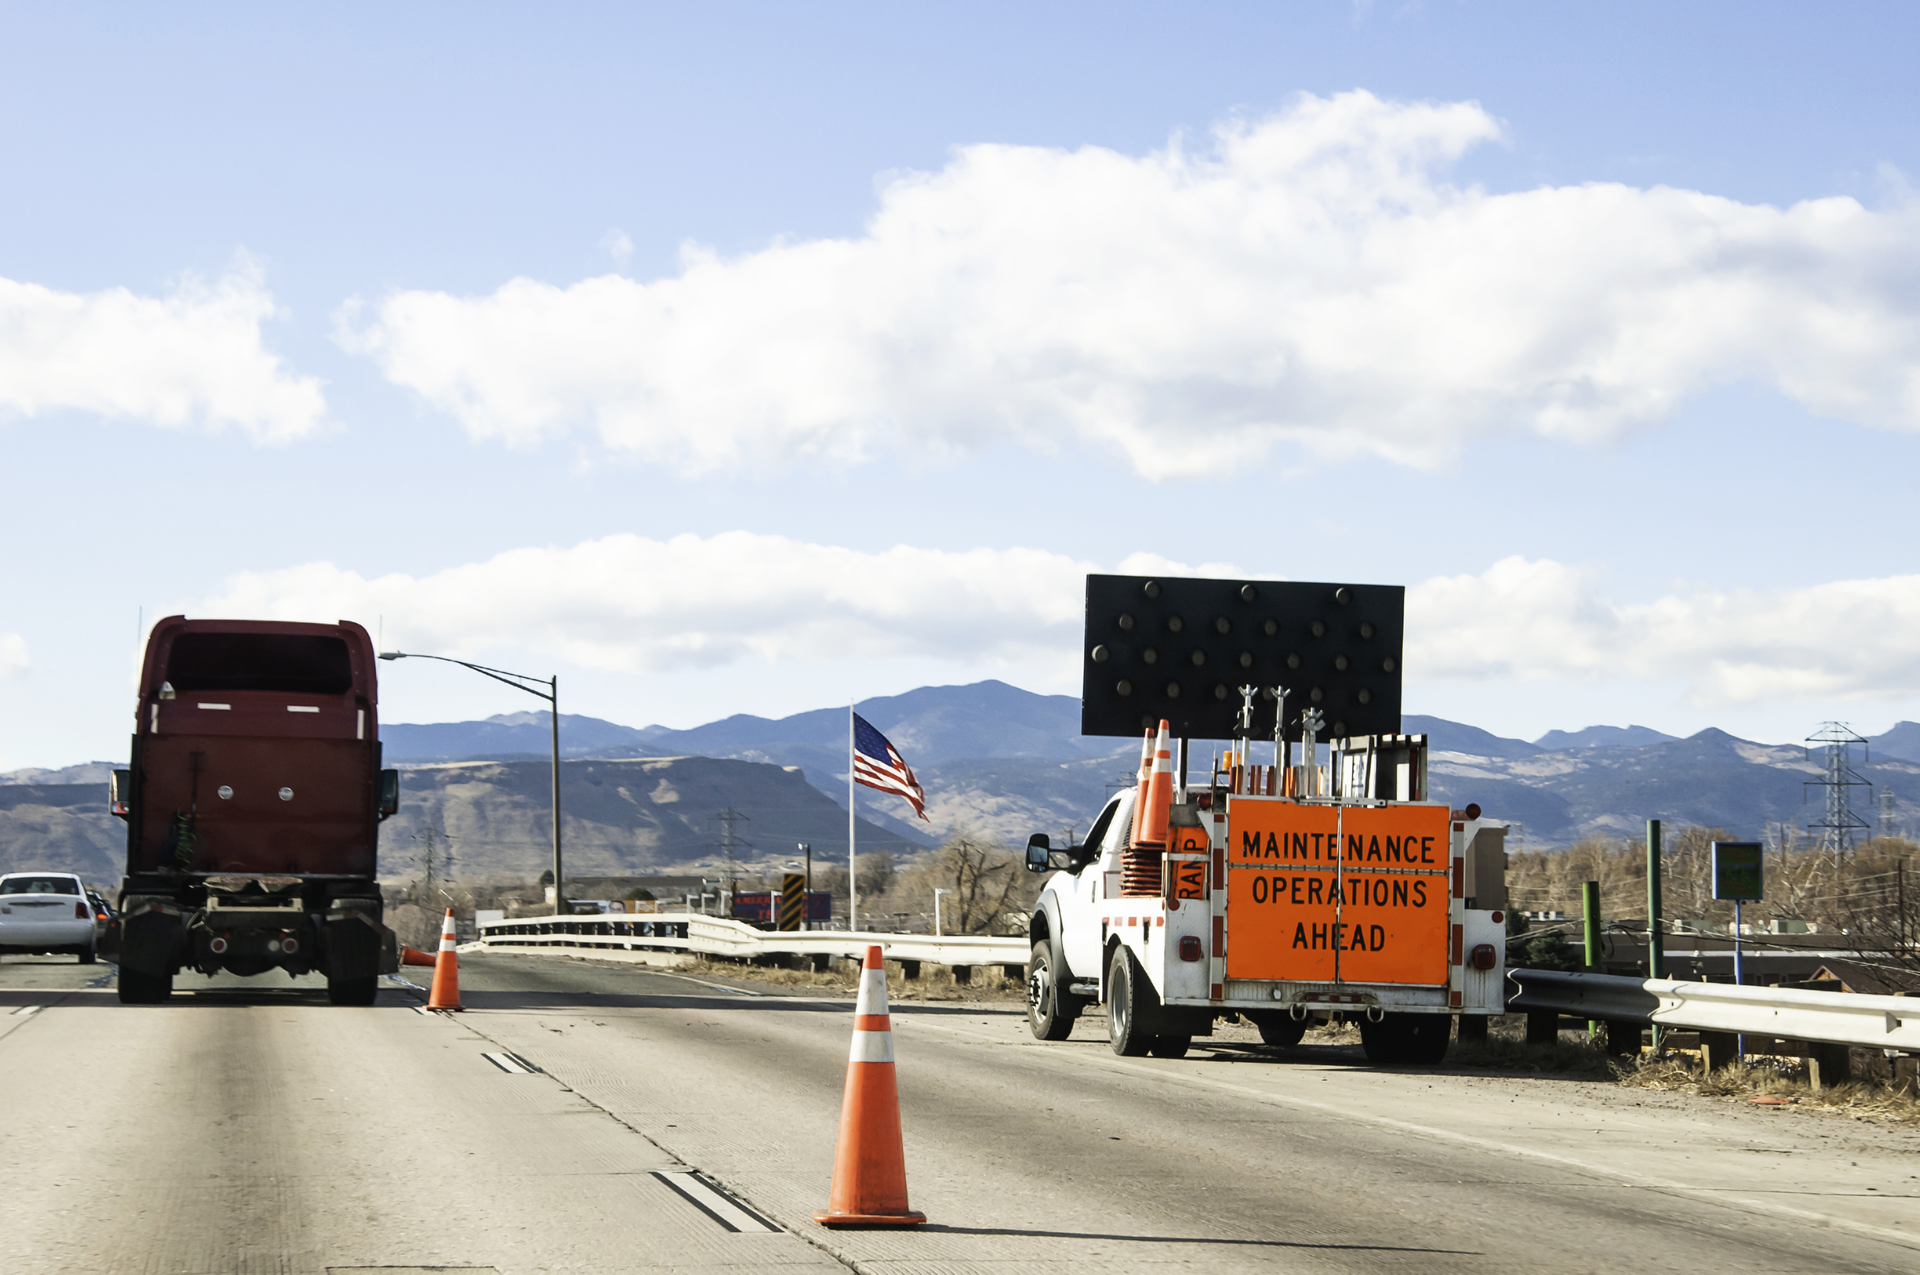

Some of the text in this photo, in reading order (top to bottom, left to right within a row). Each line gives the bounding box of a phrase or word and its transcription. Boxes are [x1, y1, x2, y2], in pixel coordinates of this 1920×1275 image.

[1243, 831, 1435, 863] MAINTENANCE
[1252, 876, 1427, 908] OPERATIONS
[1292, 922, 1385, 951] AHEAD
